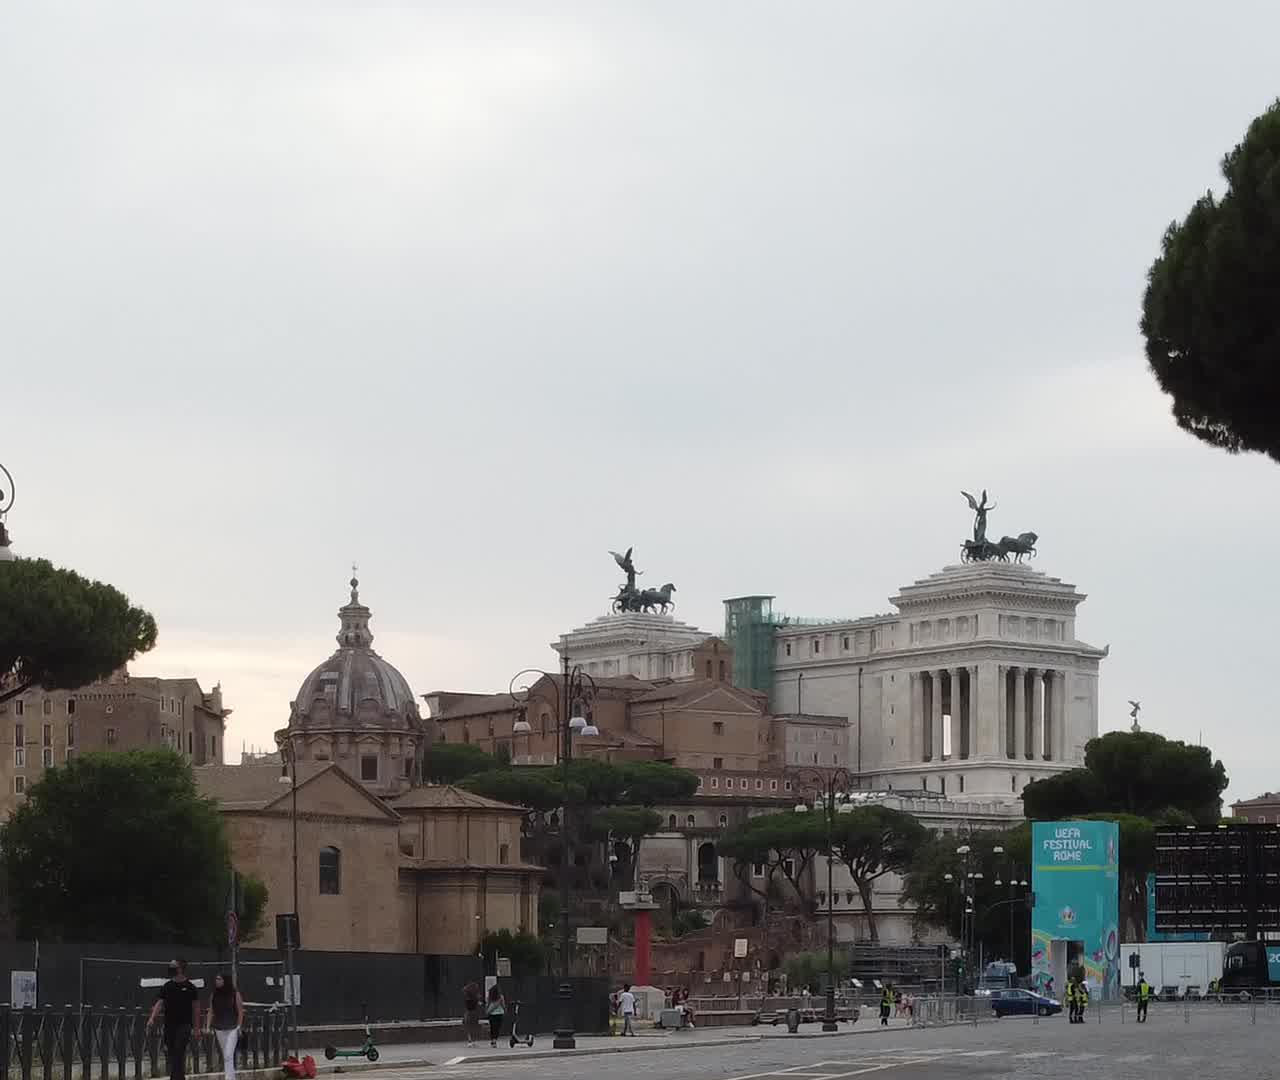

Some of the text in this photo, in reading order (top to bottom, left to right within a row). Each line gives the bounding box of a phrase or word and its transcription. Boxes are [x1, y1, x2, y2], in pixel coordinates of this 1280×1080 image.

[1054, 828, 1080, 839] UEFA
[1043, 839, 1092, 850] FESTIVAL
[1053, 850, 1082, 862] ROME
